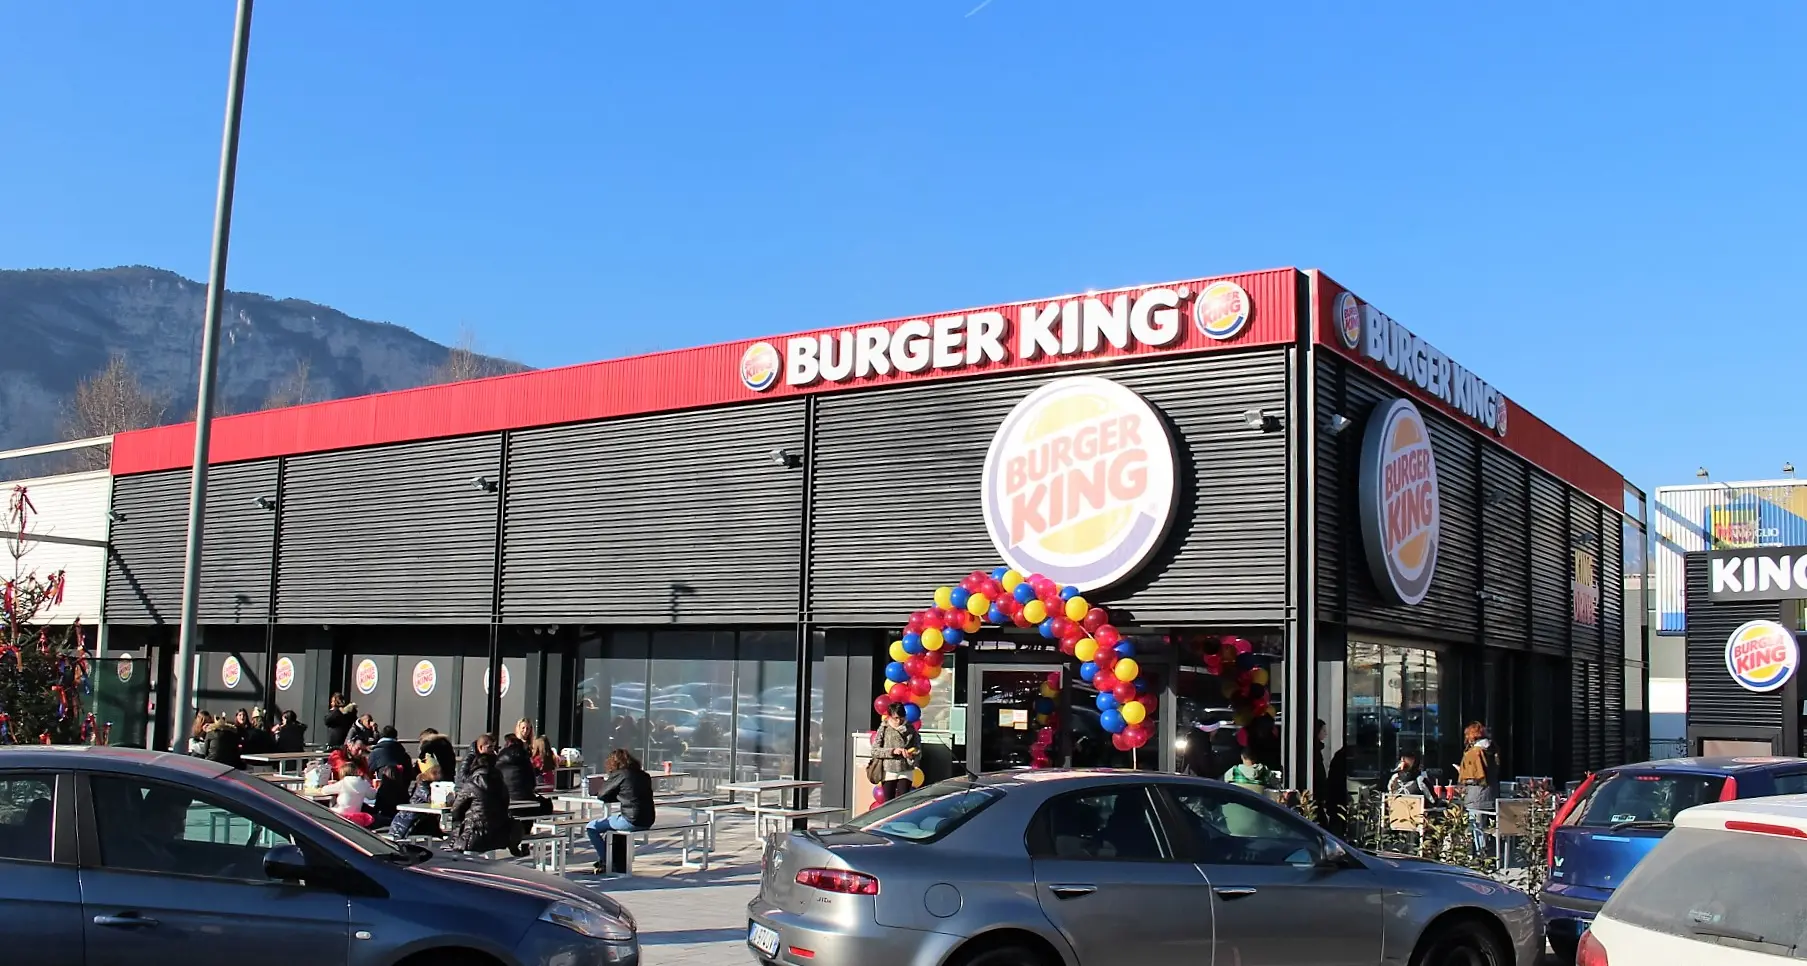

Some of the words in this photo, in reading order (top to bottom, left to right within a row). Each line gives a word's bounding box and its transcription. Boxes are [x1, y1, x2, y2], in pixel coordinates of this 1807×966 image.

[787, 311, 1005, 386] BURGER
[1020, 288, 1181, 359] KING
[1366, 304, 1451, 404] BURGER
[1453, 361, 1496, 430] KING
[1006, 413, 1143, 496] BURGER
[1385, 448, 1430, 501] BURGER
[1011, 448, 1148, 546] KING
[1388, 480, 1432, 554] KING
[1734, 634, 1784, 658] BURGR
[1737, 645, 1786, 674] KING
